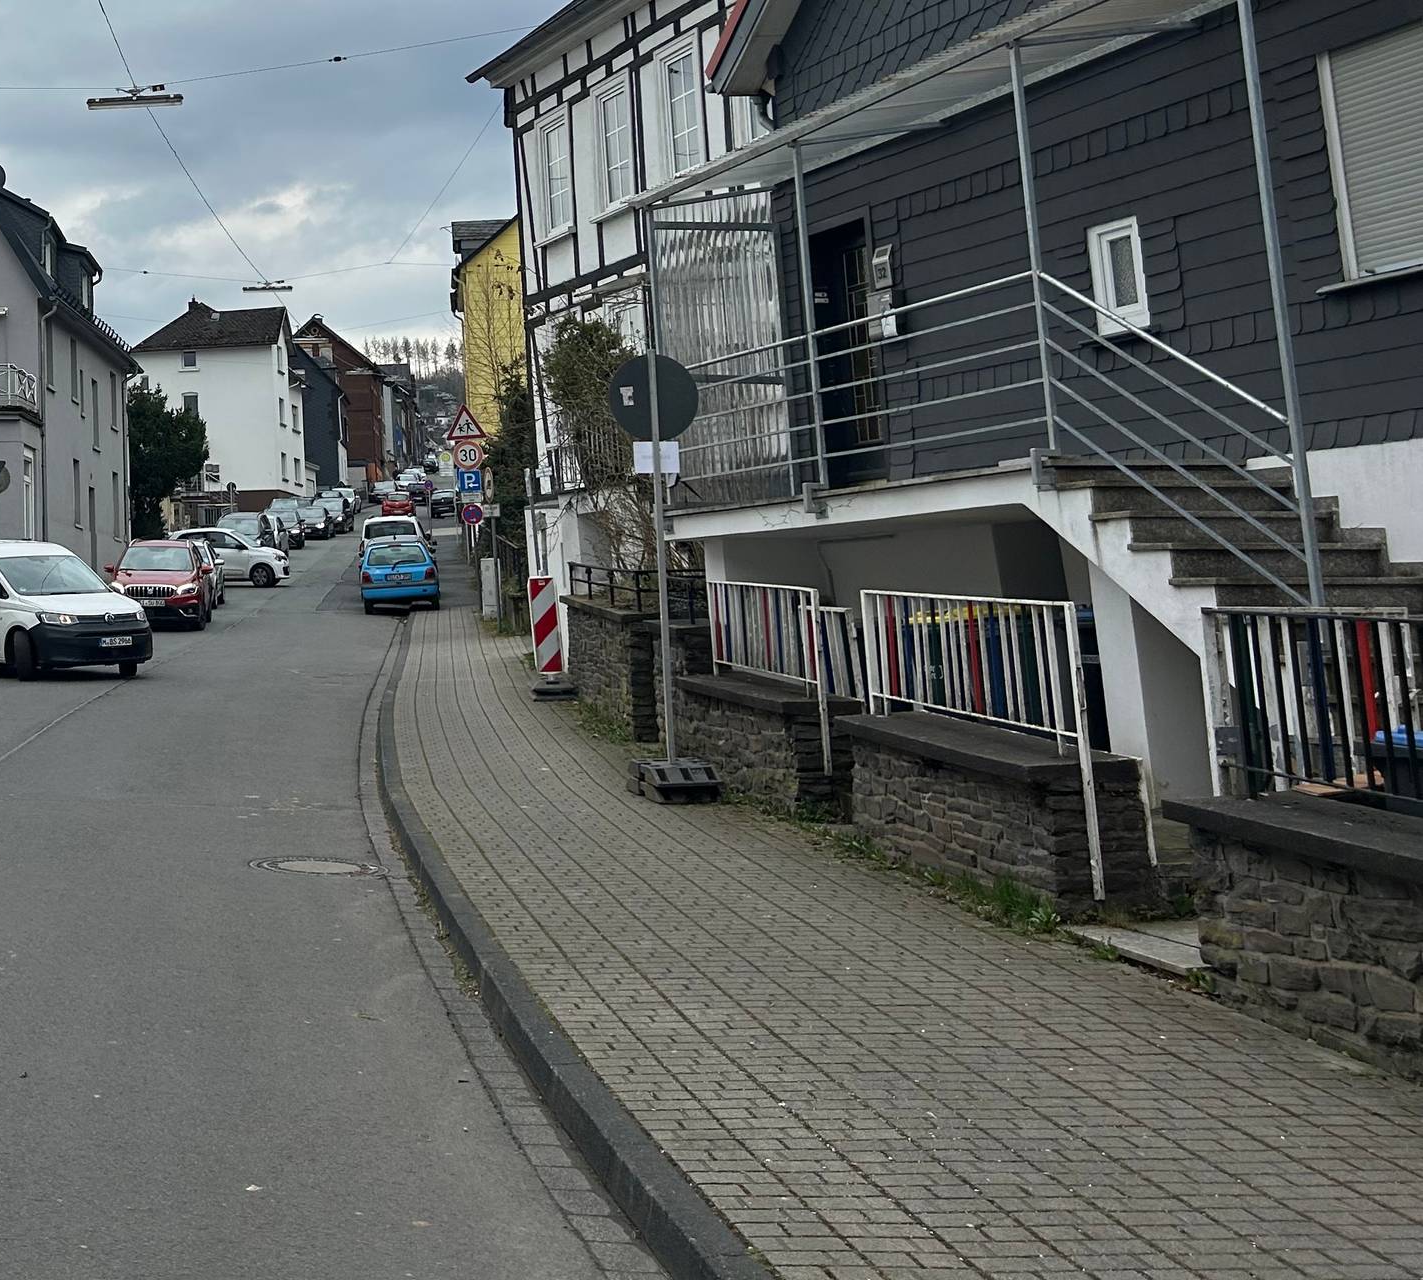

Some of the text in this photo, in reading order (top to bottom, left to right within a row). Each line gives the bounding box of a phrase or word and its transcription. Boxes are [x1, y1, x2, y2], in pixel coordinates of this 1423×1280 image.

[878, 267, 887, 279] 32
[459, 448, 477, 462] 30
[464, 473, 476, 489] P
